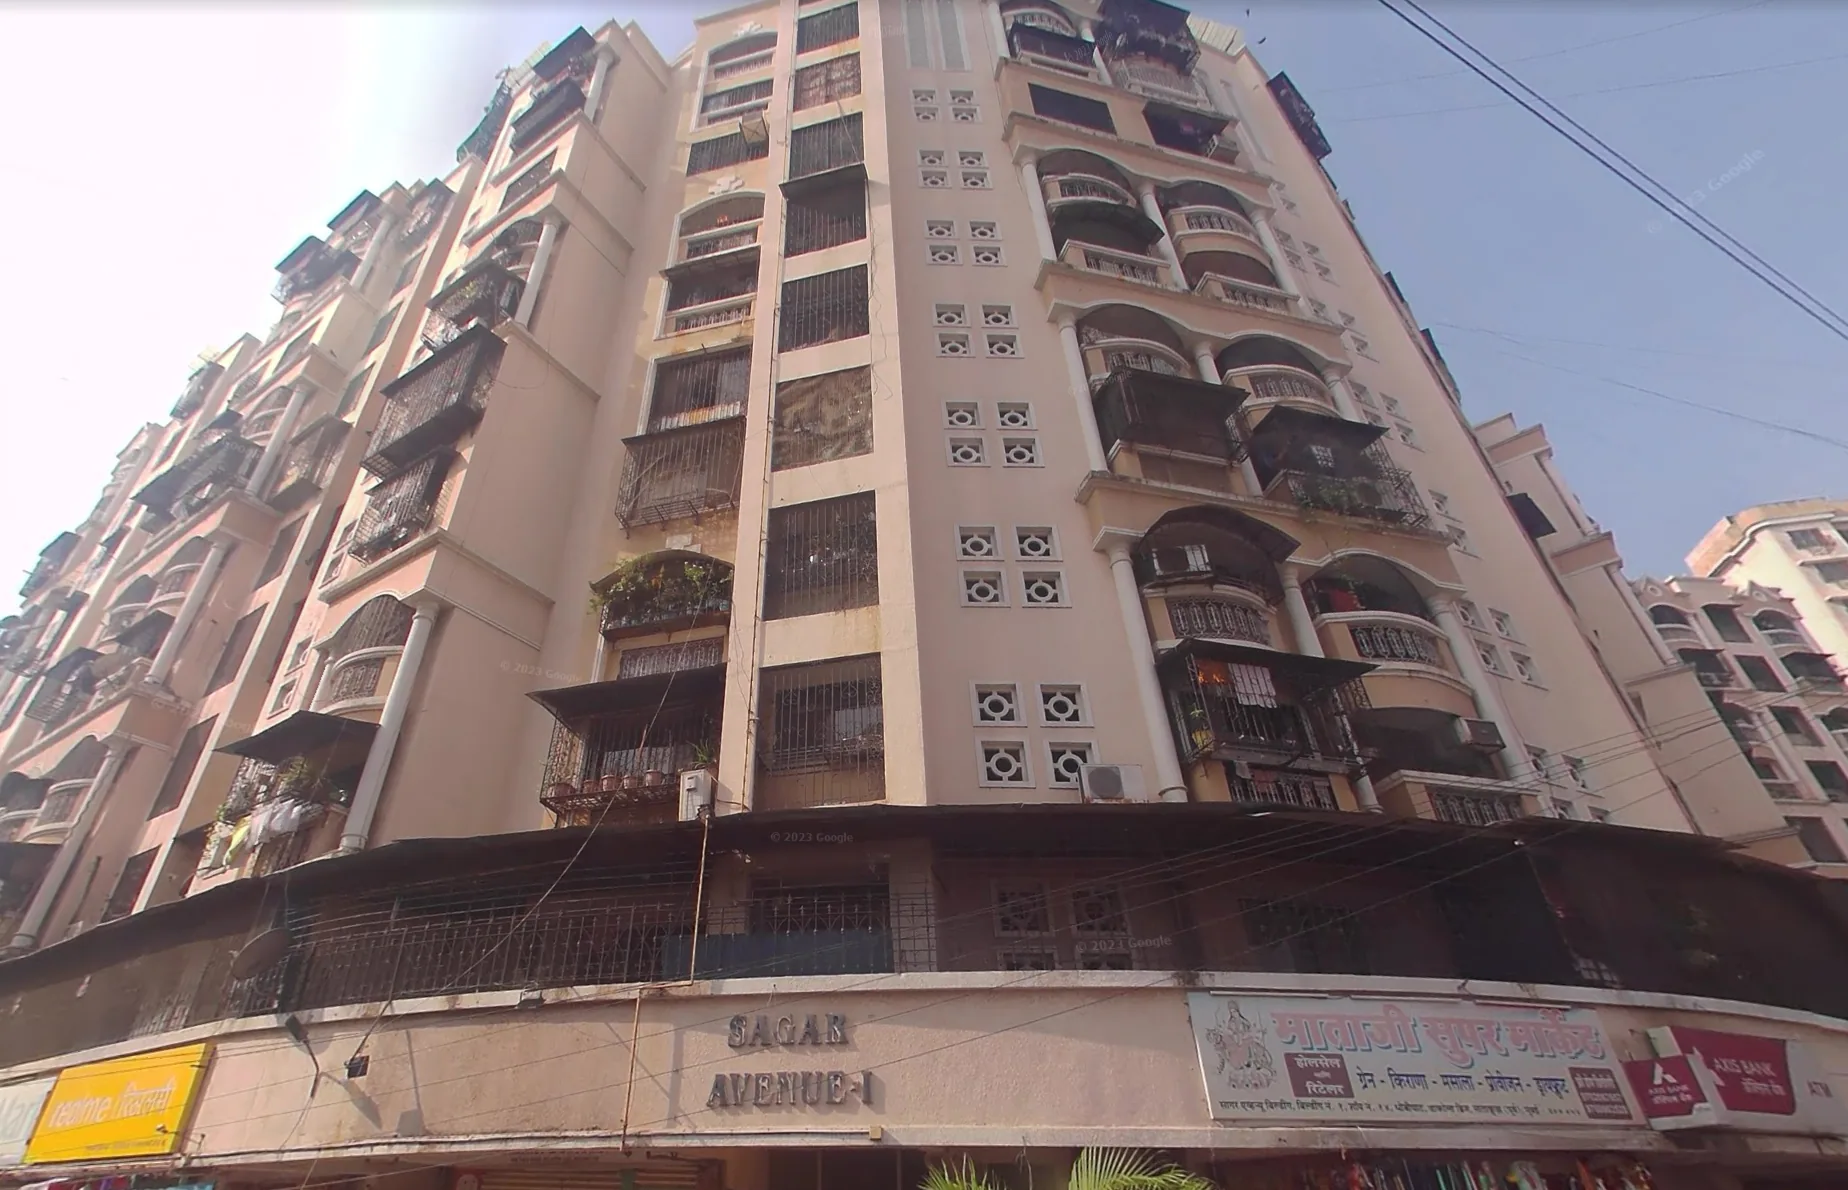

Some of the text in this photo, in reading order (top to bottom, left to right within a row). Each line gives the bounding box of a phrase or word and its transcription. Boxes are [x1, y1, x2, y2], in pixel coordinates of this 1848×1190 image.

[727, 1013, 849, 1048] SAGAR
[1270, 1003, 1422, 1053] माताजी
[1420, 1016, 1509, 1069] सुपर
[1294, 1053, 1342, 1069] होलसेल
[47, 1090, 113, 1129] realme
